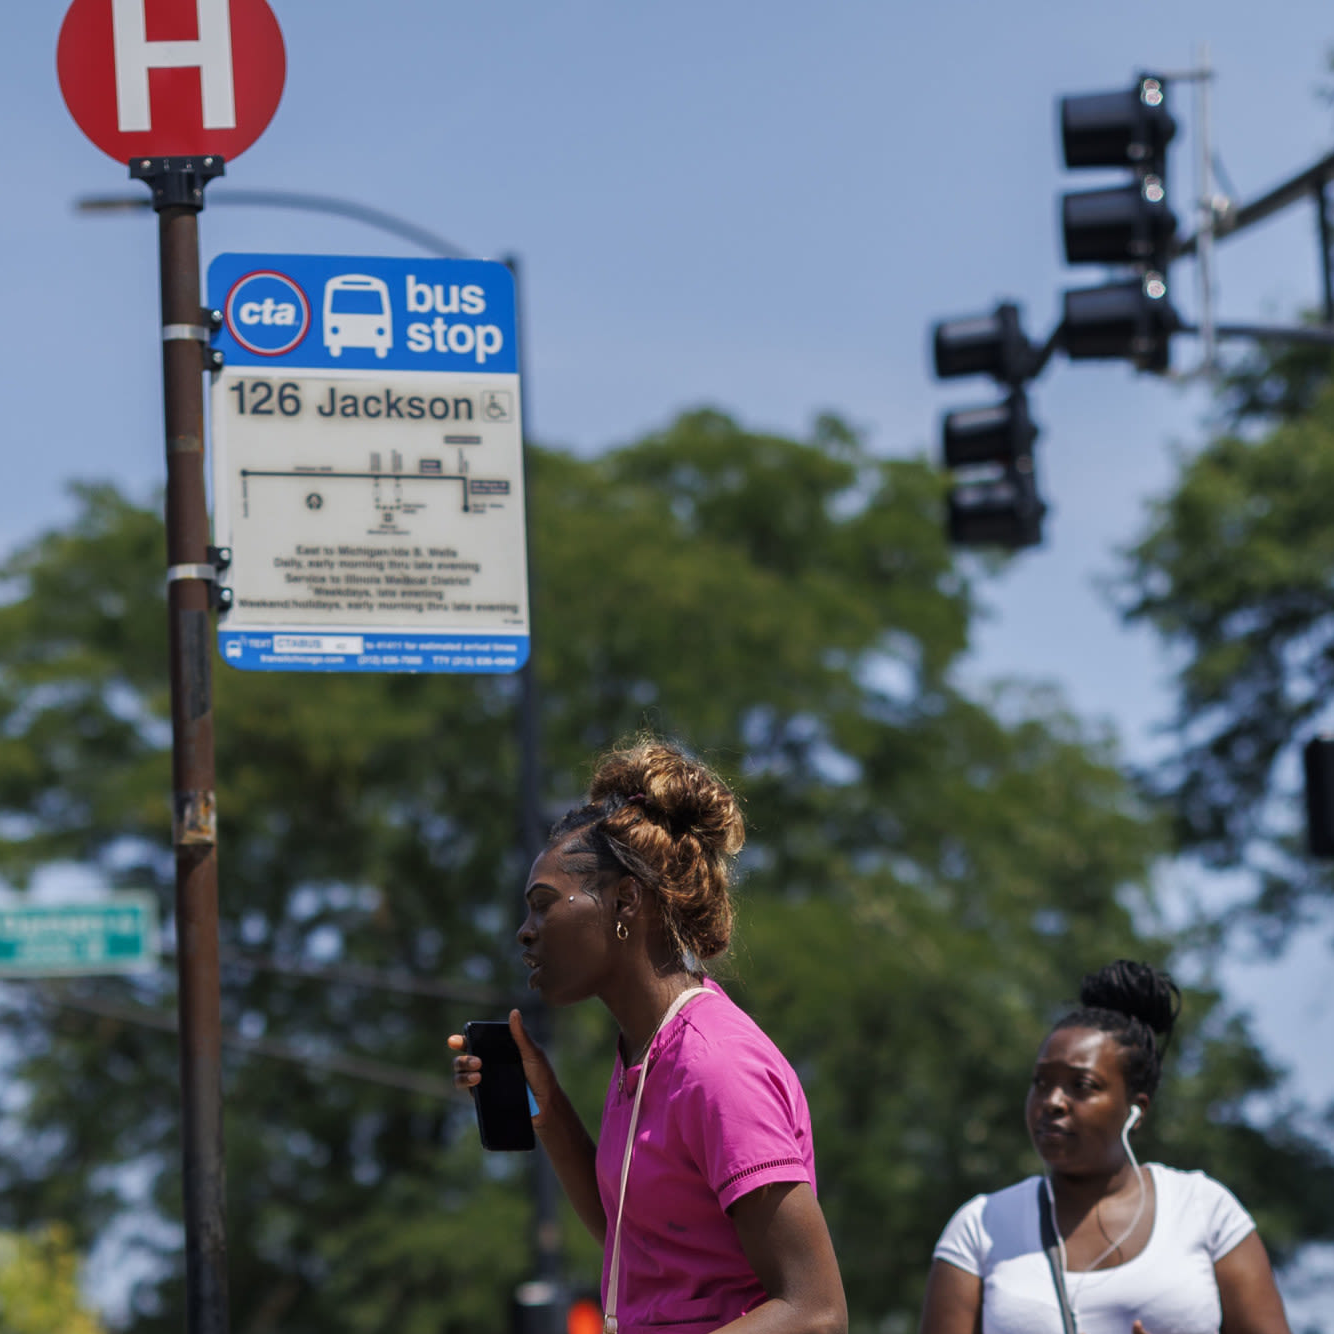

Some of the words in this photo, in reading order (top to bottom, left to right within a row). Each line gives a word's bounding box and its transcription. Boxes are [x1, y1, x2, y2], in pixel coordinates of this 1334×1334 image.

[111, 0, 237, 132] H
[405, 274, 486, 315] bus
[239, 297, 296, 326] cta
[406, 317, 503, 364] stop
[229, 381, 301, 417] 126
[317, 387, 474, 420] Jackson
[296, 544, 320, 556] East
[308, 559, 334, 571] early
[340, 560, 385, 572] morning
[389, 560, 410, 570] thru
[414, 561, 433, 570] late
[437, 562, 480, 573] evening
[285, 572, 326, 584] Service
[378, 589, 397, 598] late
[401, 589, 443, 601] evening
[347, 601, 373, 612] early
[378, 601, 423, 613] morning
[427, 602, 449, 611] thru
[453, 603, 471, 612] late
[475, 603, 519, 615] evening
